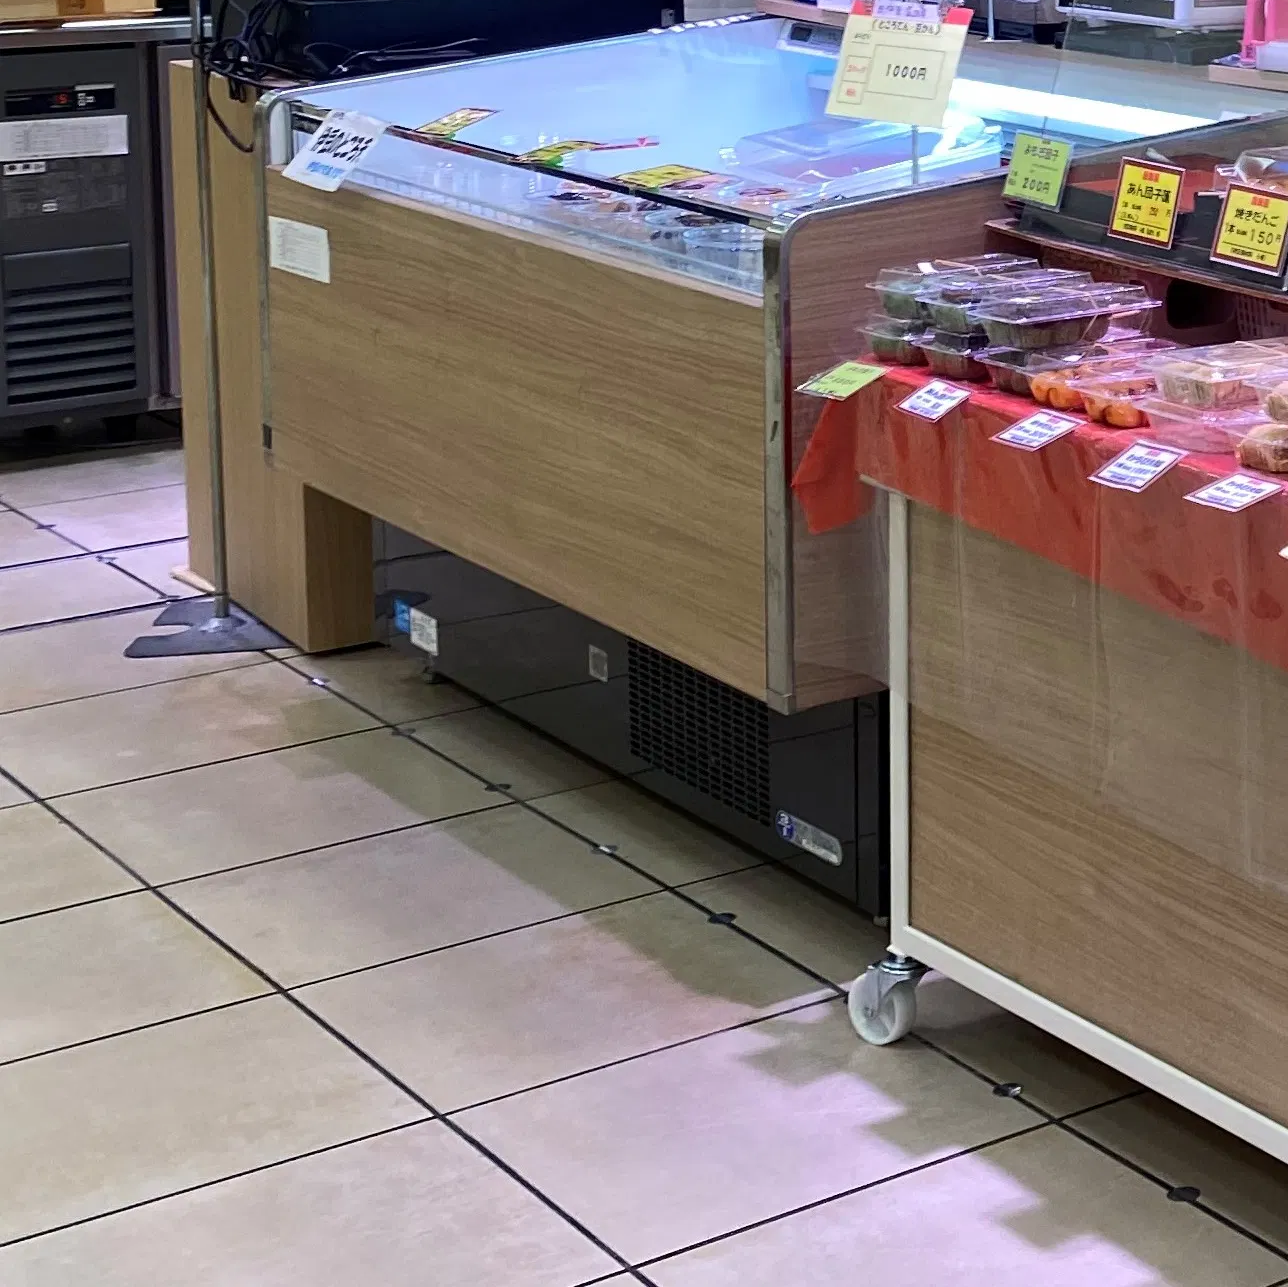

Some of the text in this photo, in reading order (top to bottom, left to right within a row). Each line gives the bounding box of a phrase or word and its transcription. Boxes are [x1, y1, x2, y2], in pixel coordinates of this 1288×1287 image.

[886, 63, 928, 81] 1000円
[1235, 208, 1280, 227] 焼きだんご
